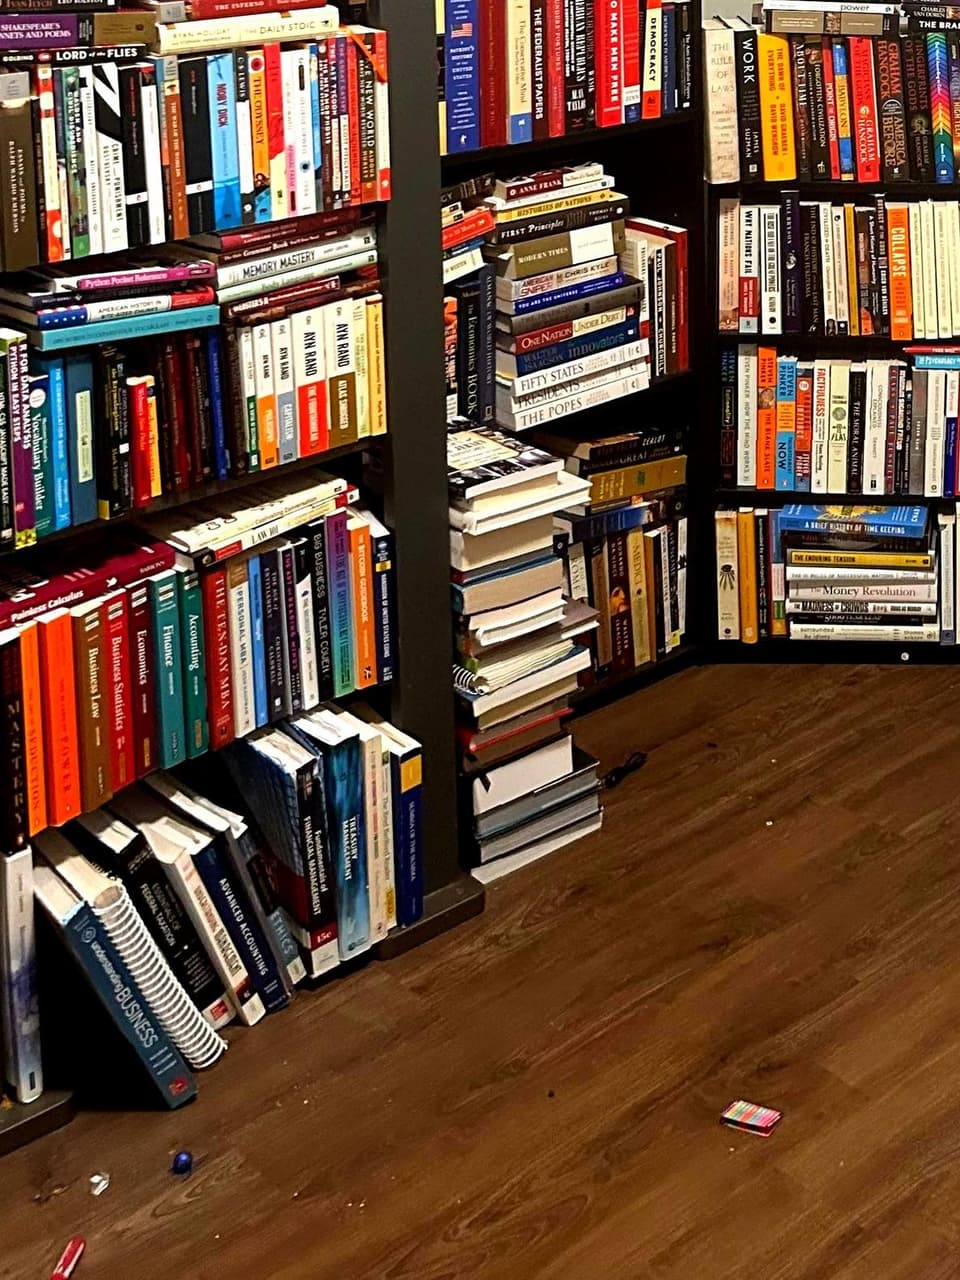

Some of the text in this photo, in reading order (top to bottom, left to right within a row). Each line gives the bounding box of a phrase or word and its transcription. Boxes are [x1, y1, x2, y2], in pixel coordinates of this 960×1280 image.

[840, 4, 870, 13] power
[919, 21, 937, 29] THE
[260, 21, 315, 34] DAILY STOIC
[610, 13, 618, 43] MAKE
[610, 47, 618, 67] MEN
[649, 18, 657, 82] DEMOCRACY
[742, 39, 755, 83] WORK
[878, 41, 889, 99] HANCOCK
[888, 43, 899, 94] GRAHAM
[610, 71, 618, 103] FREE
[519, 178, 562, 195] ANNE FRANK
[517, 195, 592, 217] HISTORIES OF NATIONS
[501, 219, 564, 239] FIRST Principles
[744, 210, 752, 274] WHY NATIONS FAIL
[243, 251, 315, 278] MEMORY MASTERY
[891, 227, 906, 278] COLLAPSE
[304, 331, 317, 377] AYN RAND
[521, 363, 584, 391] FIFTY STATES
[521, 398, 582, 427] THE POPES
[778, 442, 786, 470] NOW
[11, 590, 84, 624] Painless Calculus
[823, 585, 915, 596] Money Revolution
[136, 629, 148, 685] Economics
[163, 624, 173, 667] Finance
[188, 614, 199, 670] Accounting
[88, 647, 101, 719] Business Law
[218, 878, 269, 977] ADVANCED ACCOUNTING
[270, 912, 292, 956] ETHICS
[115, 986, 159, 1049] BUSINESS
